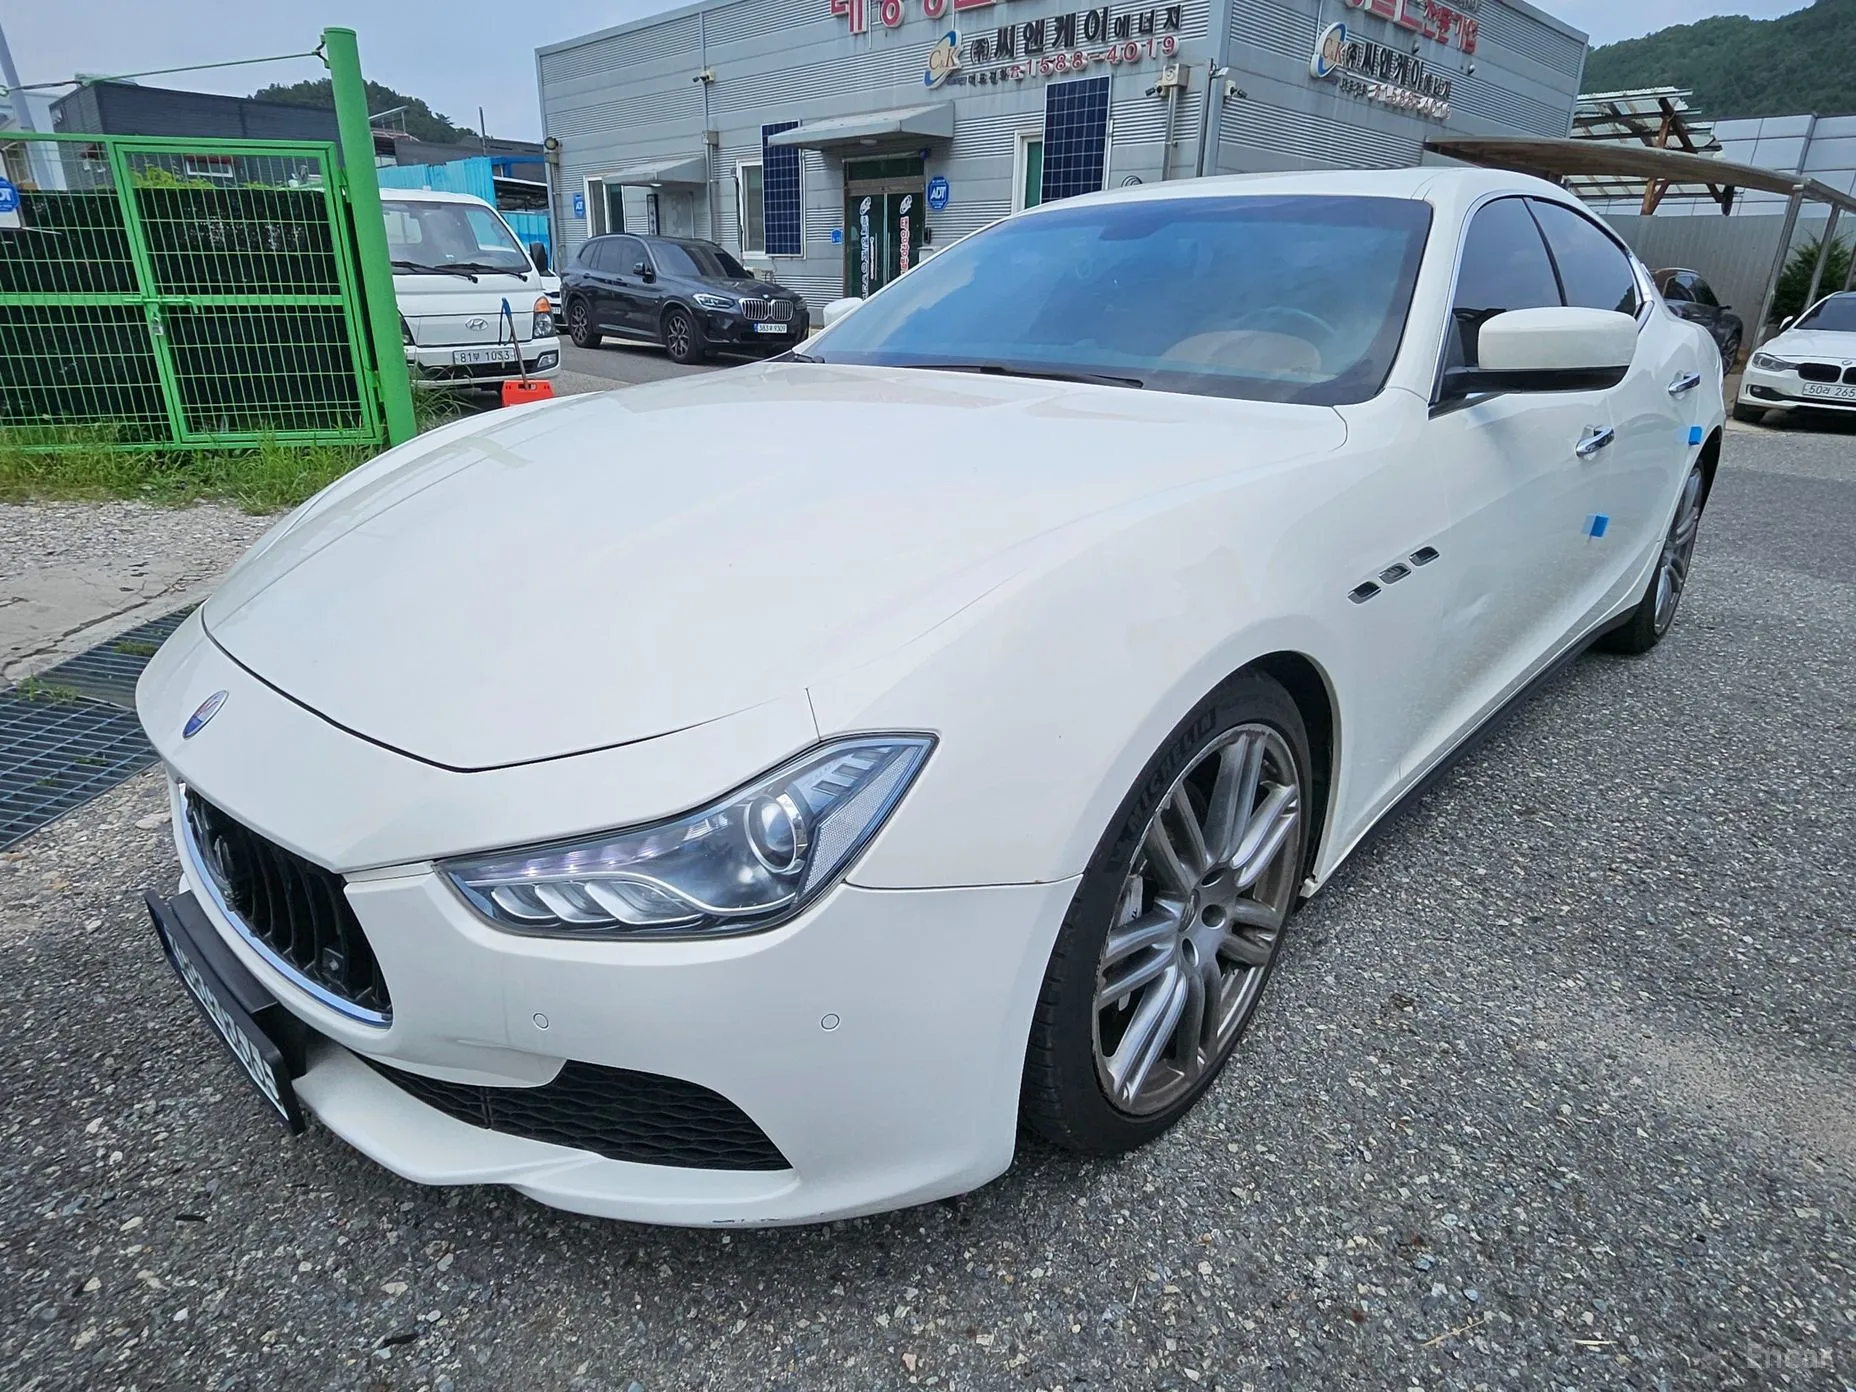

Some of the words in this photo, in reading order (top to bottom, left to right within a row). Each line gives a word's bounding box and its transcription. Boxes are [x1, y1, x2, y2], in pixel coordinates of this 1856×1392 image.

[1026, 35, 1175, 77] 1588-4019
[930, 186, 946, 199] ADT
[1835, 387, 1856, 397] 265
[1124, 706, 1217, 838] MICHELIN
